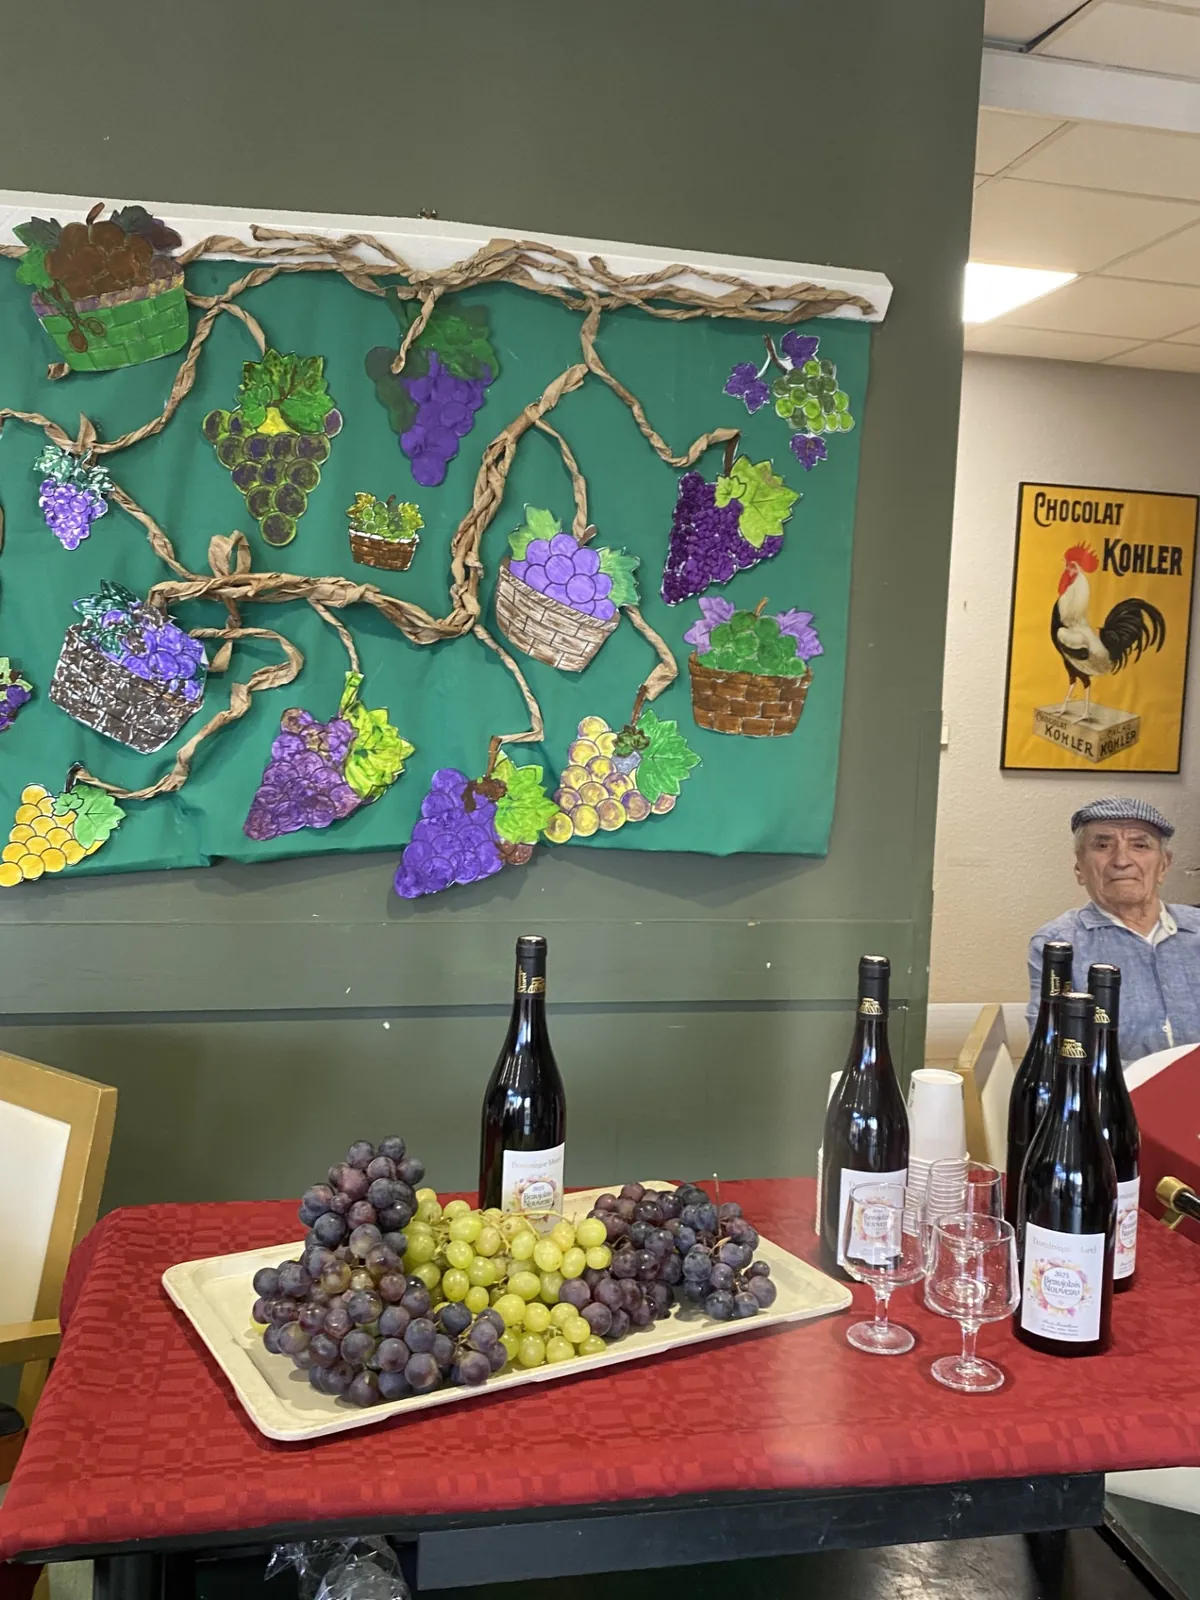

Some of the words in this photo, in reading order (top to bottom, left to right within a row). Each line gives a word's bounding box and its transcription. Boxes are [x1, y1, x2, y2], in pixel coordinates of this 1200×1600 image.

[1034, 491, 1124, 527] CHOCOLAT
[1102, 538, 1182, 576] KOHLER
[1045, 724, 1094, 757] KOHLER
[1100, 730, 1137, 757] KOHLER
[1044, 1275, 1080, 1289] Beaujolais
